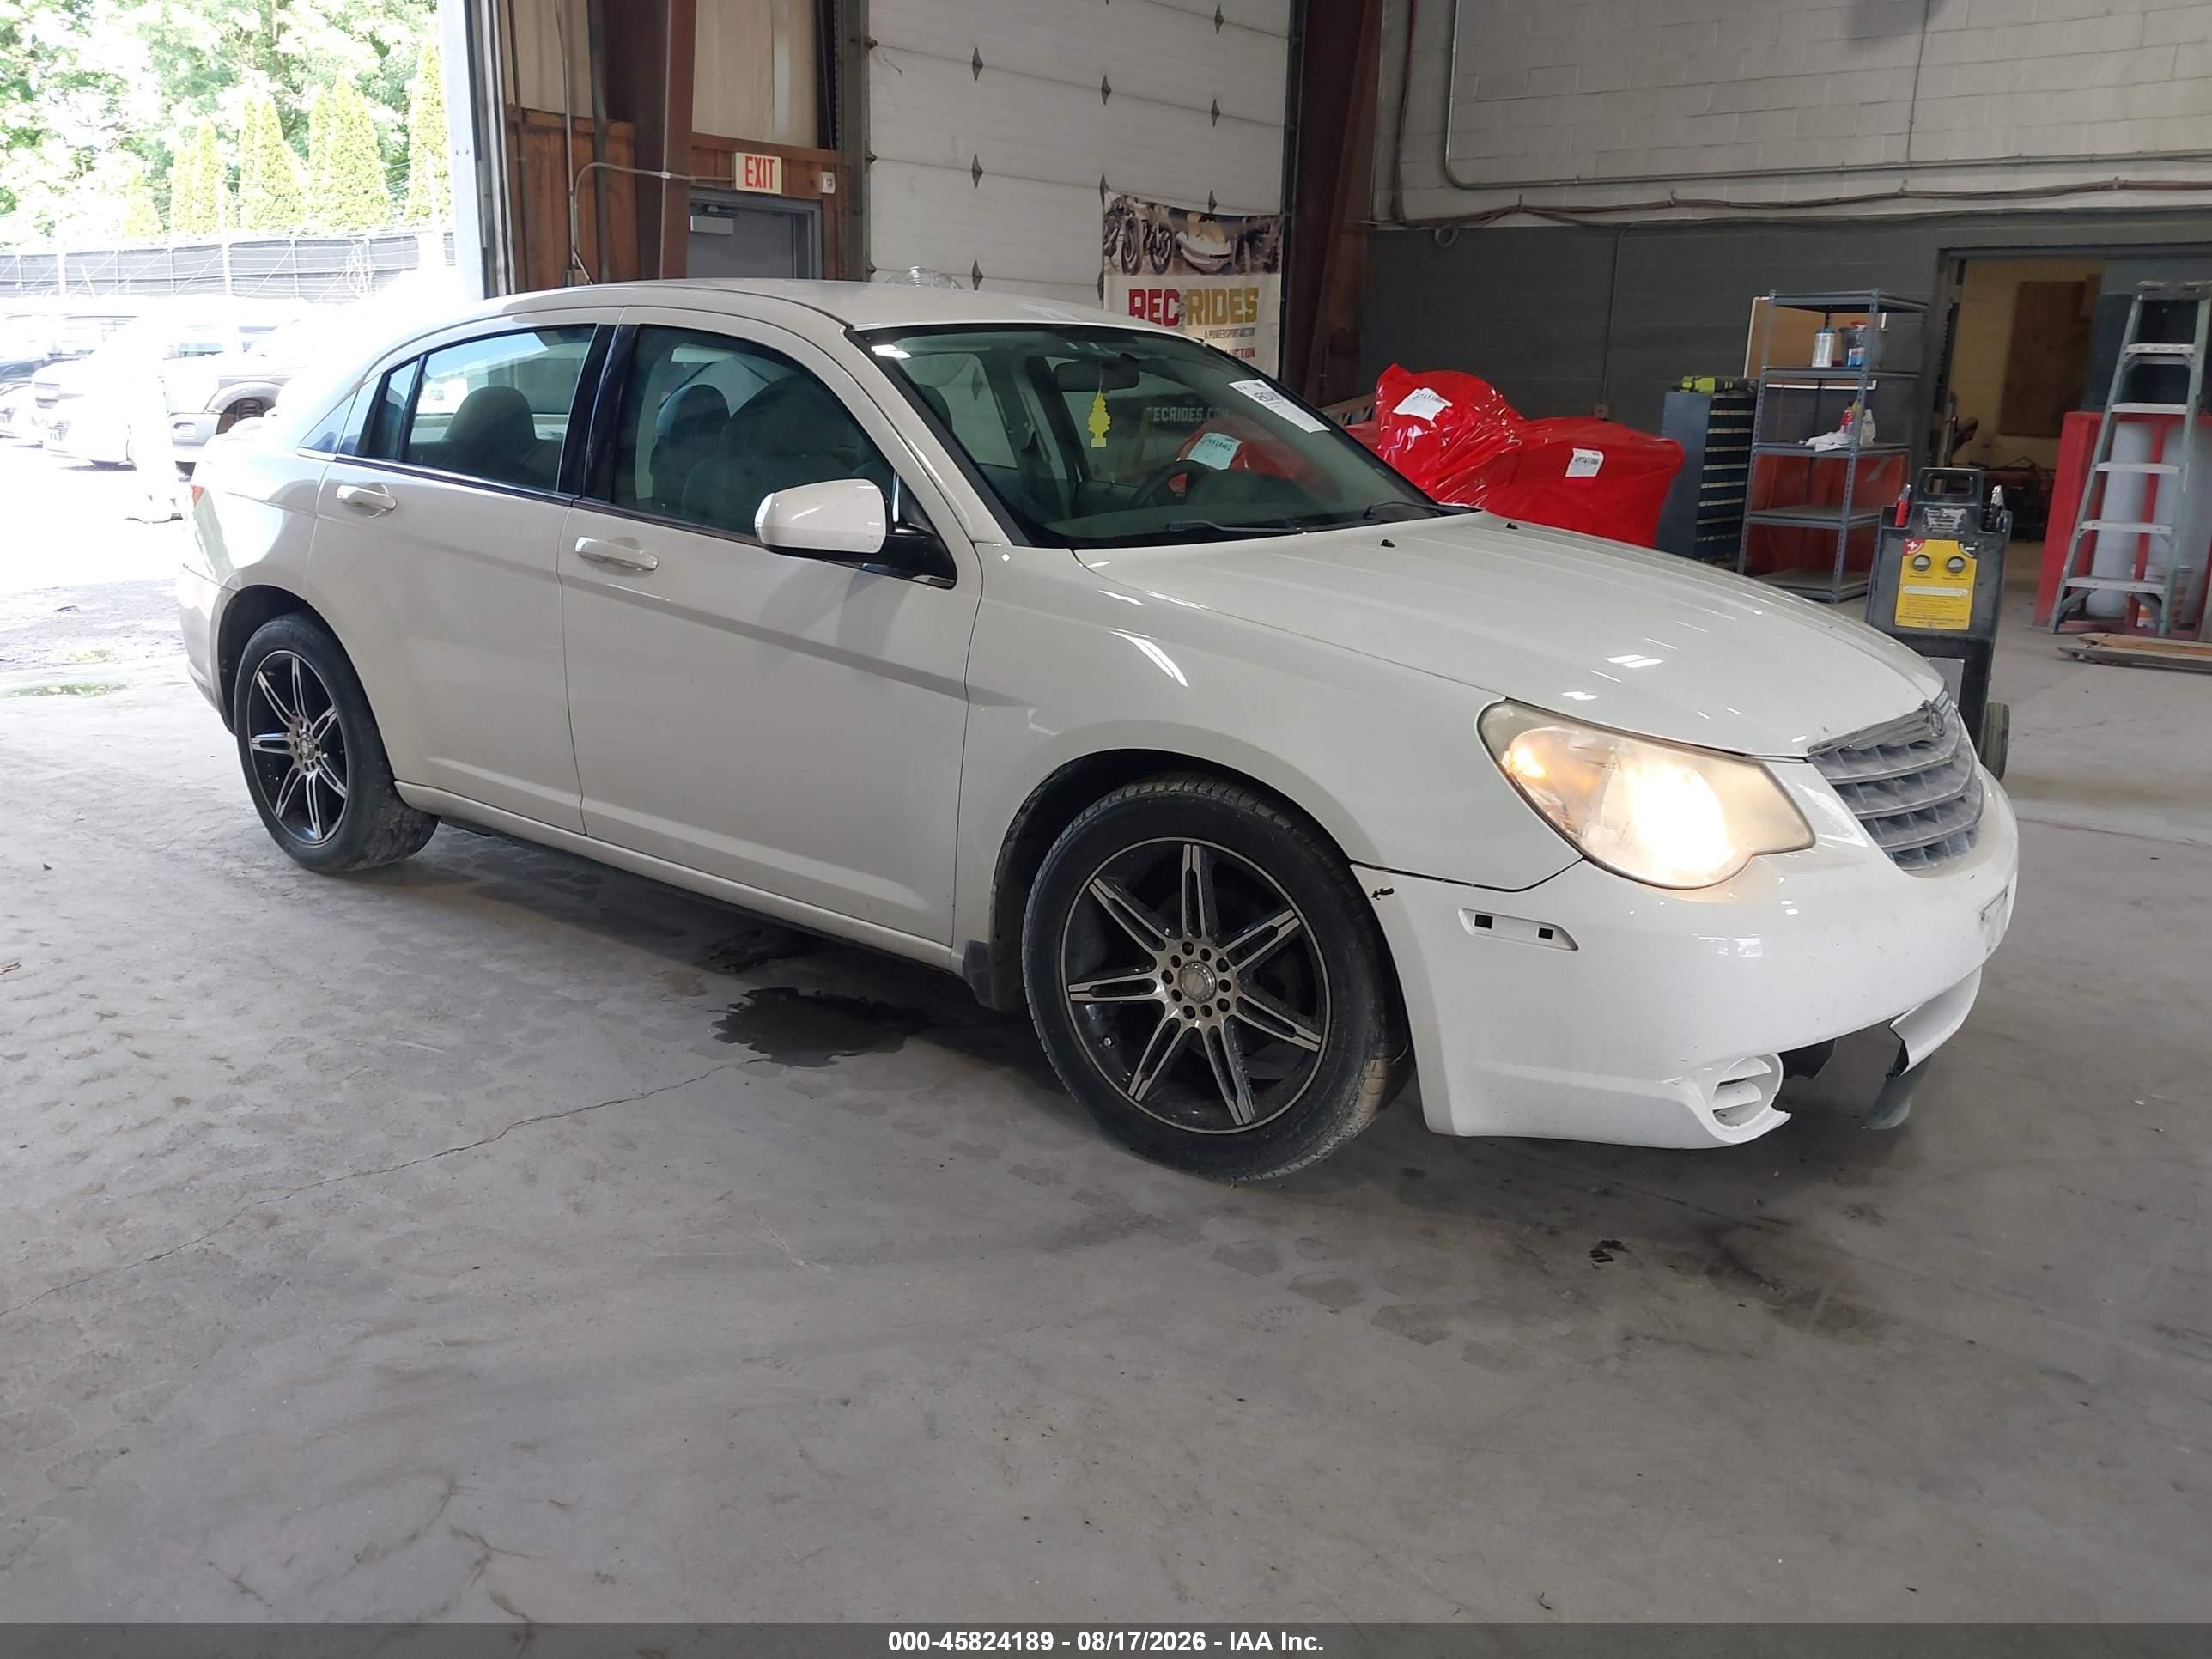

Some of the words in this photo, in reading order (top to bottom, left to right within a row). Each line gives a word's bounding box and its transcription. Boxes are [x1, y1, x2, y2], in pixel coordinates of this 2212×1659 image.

[744, 155, 775, 190] EXIT
[1128, 289, 1180, 327] REC
[1186, 288, 1259, 326] RIDES
